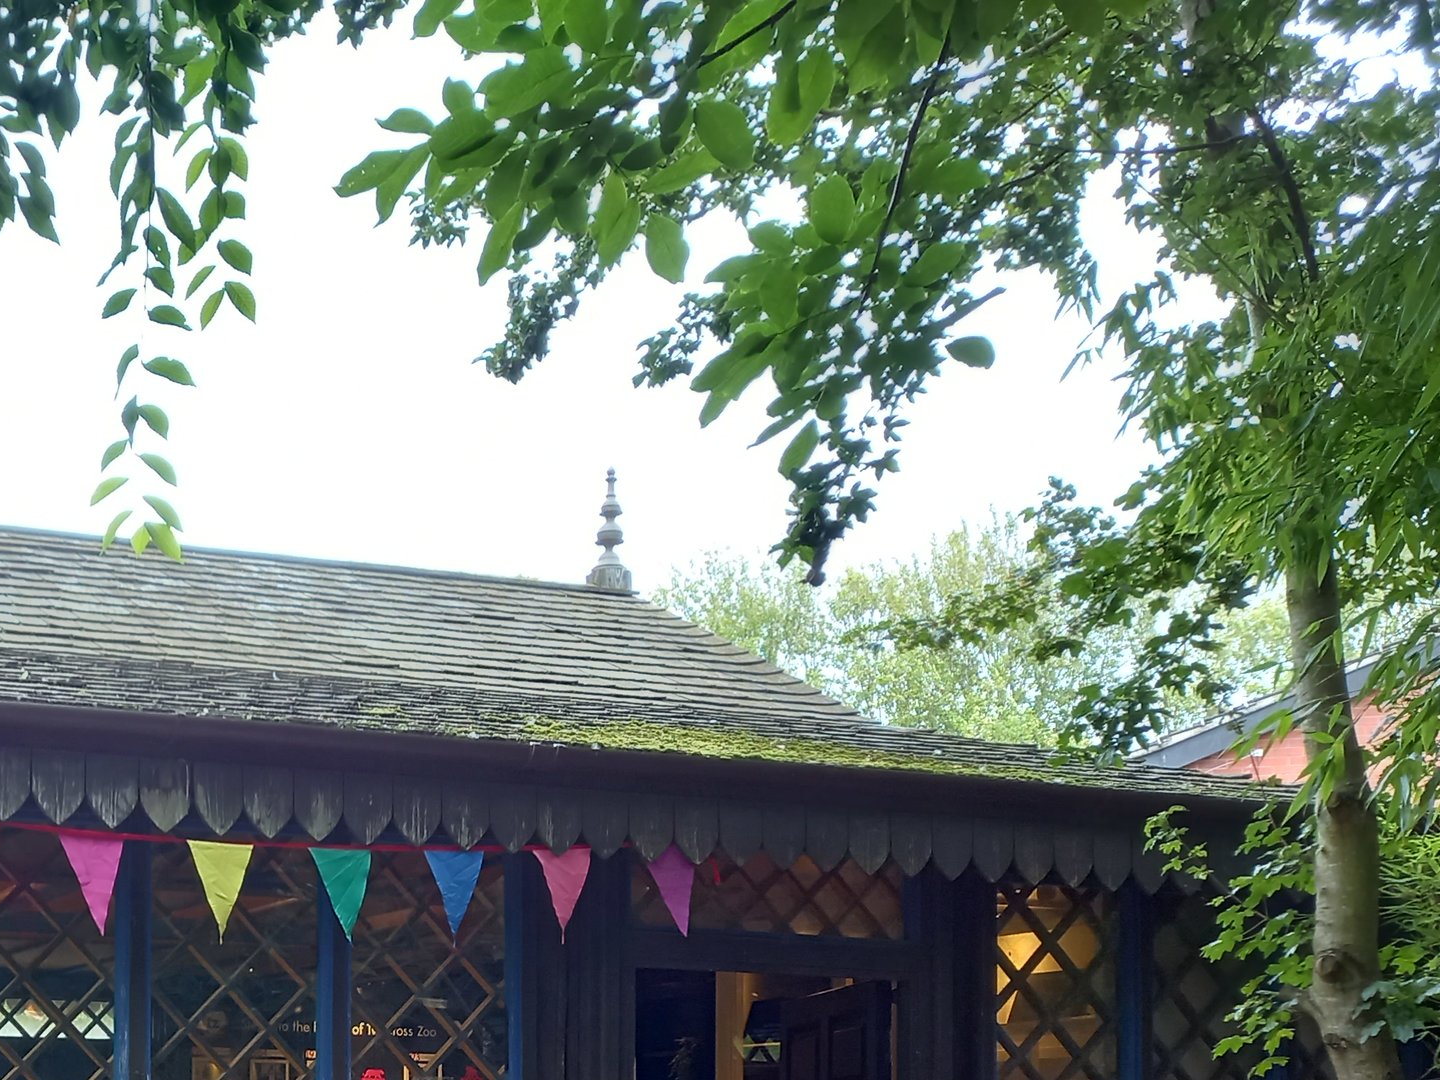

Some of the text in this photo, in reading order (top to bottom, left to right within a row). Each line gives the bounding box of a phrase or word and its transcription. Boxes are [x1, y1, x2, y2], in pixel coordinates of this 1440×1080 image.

[292, 1020, 310, 1033] the
[351, 1021, 365, 1036] of
[417, 1025, 437, 1037] Zoo
